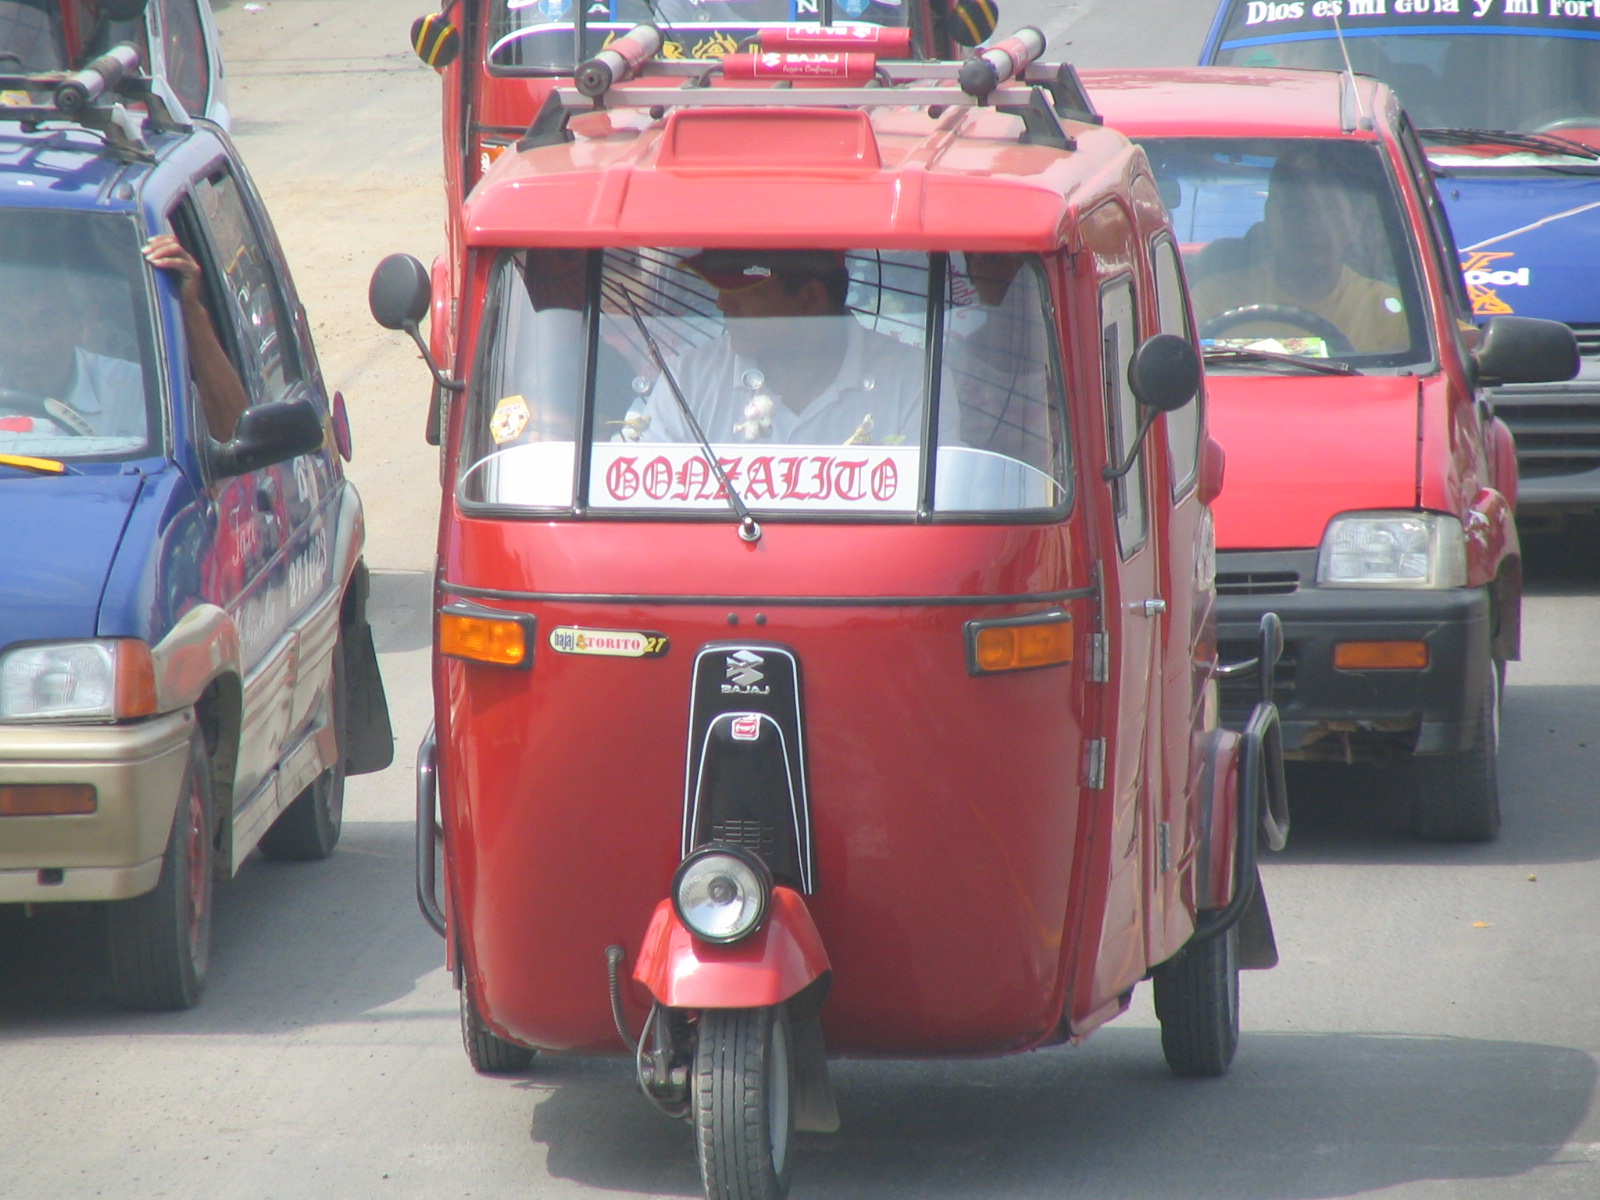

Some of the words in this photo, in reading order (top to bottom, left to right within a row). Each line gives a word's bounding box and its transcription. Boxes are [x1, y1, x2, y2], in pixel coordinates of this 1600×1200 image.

[1245, 1, 1304, 25] Dios
[1312, 0, 1342, 17] es
[1348, 0, 1387, 16] mi
[1473, 0, 1493, 17] y
[1504, 0, 1539, 15] mi
[786, 53, 839, 63] BAJAJ
[606, 455, 899, 501] GONZALITO
[554, 632, 575, 651] bajaj
[587, 637, 641, 650] TORITO
[721, 684, 771, 695] BAJAJ
